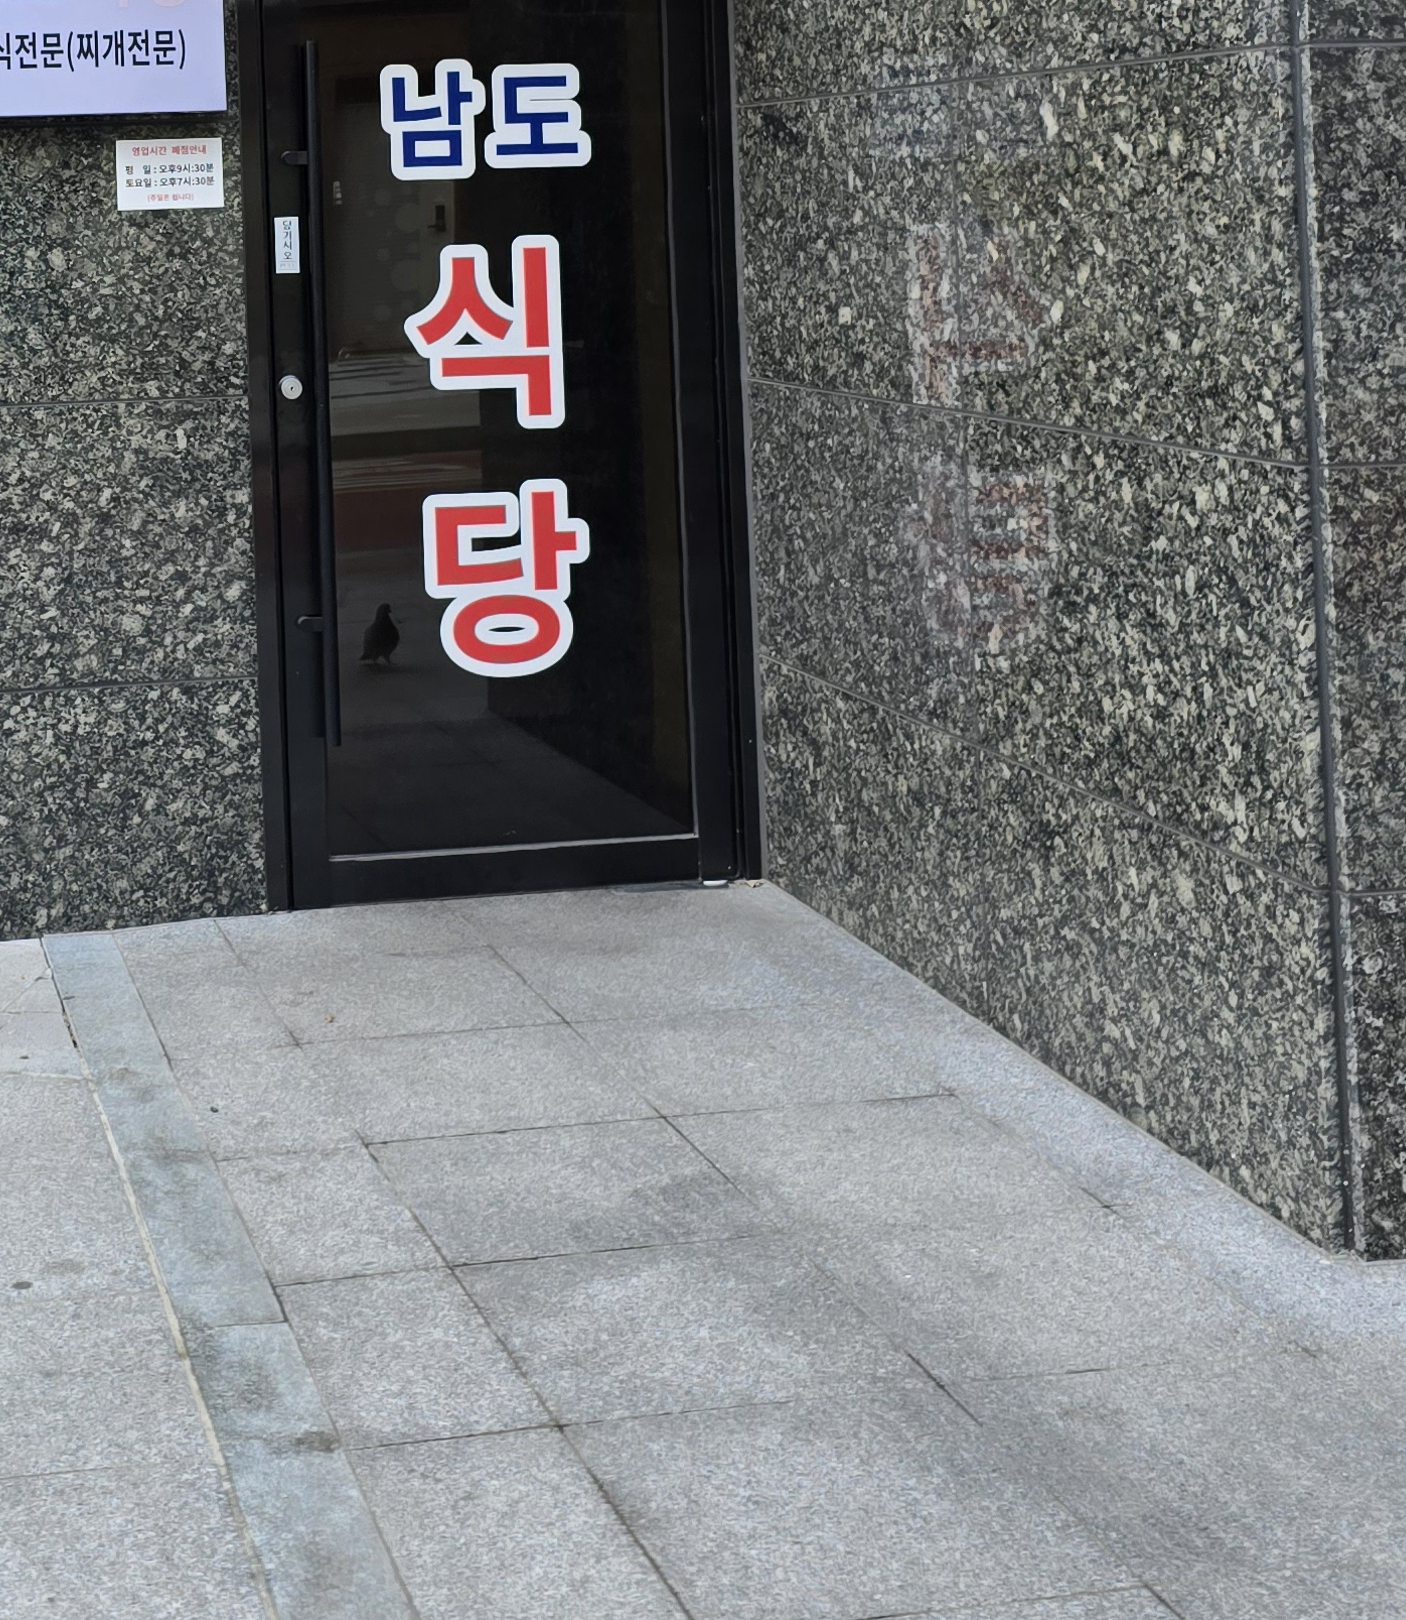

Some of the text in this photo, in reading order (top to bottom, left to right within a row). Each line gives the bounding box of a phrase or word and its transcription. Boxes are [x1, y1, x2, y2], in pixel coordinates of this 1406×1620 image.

[132, 146, 167, 156] 영업시간
[384, 62, 589, 177] 남도
[282, 220, 293, 260] 당기시오
[406, 237, 588, 676] 식당
